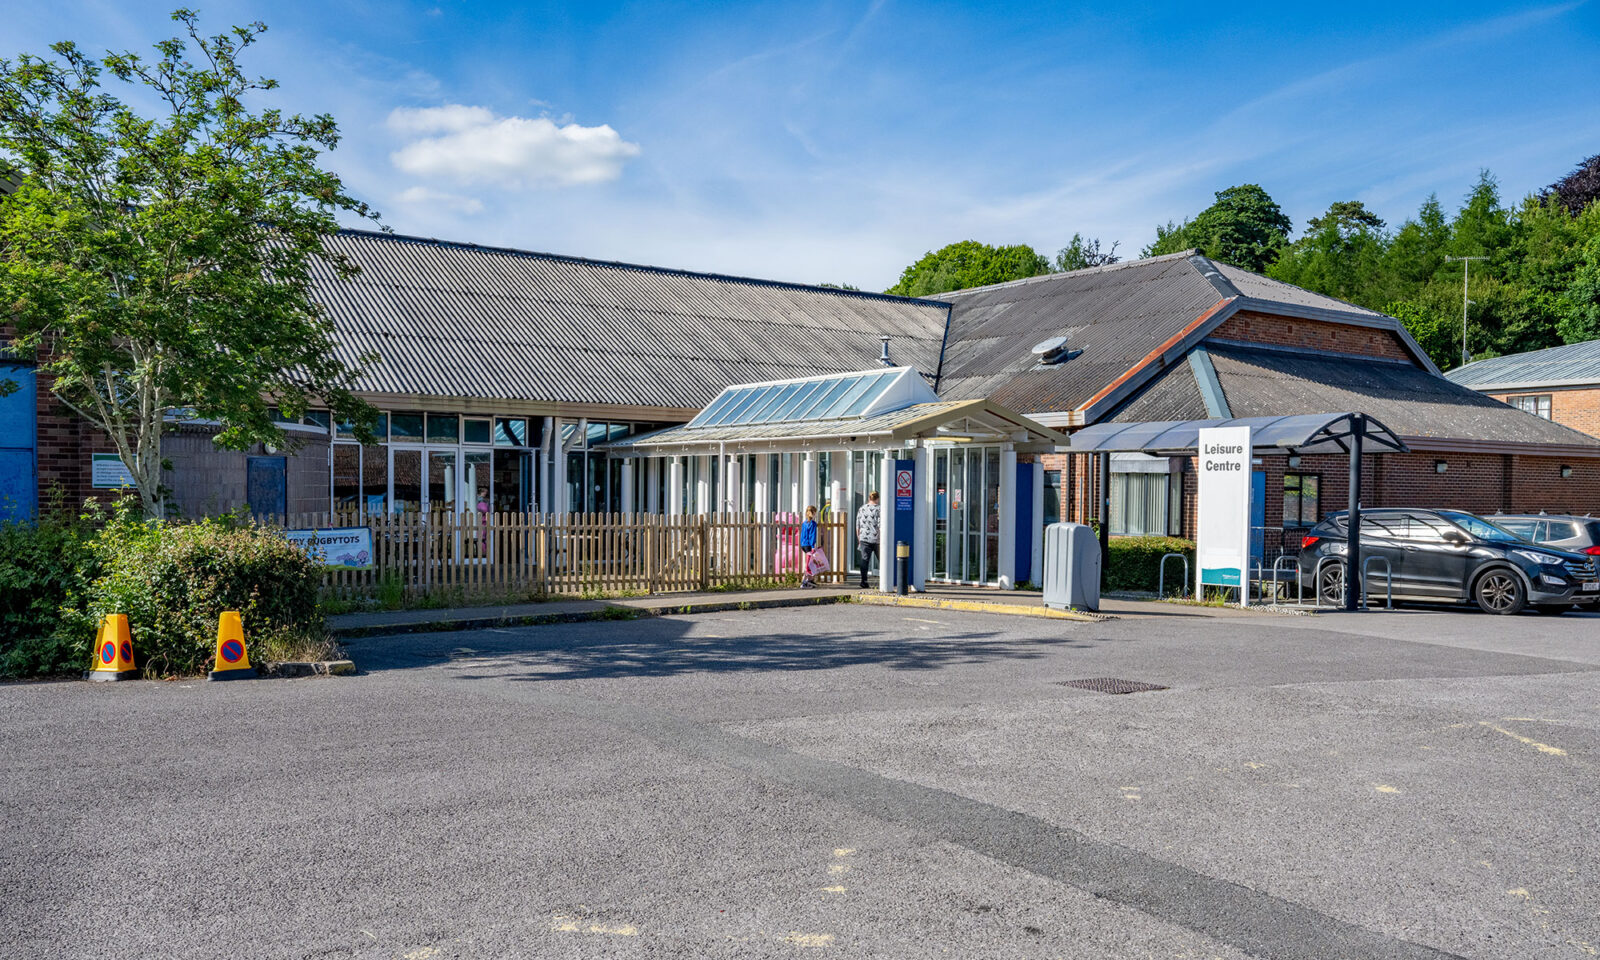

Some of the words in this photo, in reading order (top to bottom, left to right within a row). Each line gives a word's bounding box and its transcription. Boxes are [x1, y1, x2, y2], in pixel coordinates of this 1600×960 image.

[1204, 444, 1242, 454] Leisure
[1206, 460, 1241, 472] Centre
[308, 536, 360, 546] RUGBYTOTS
